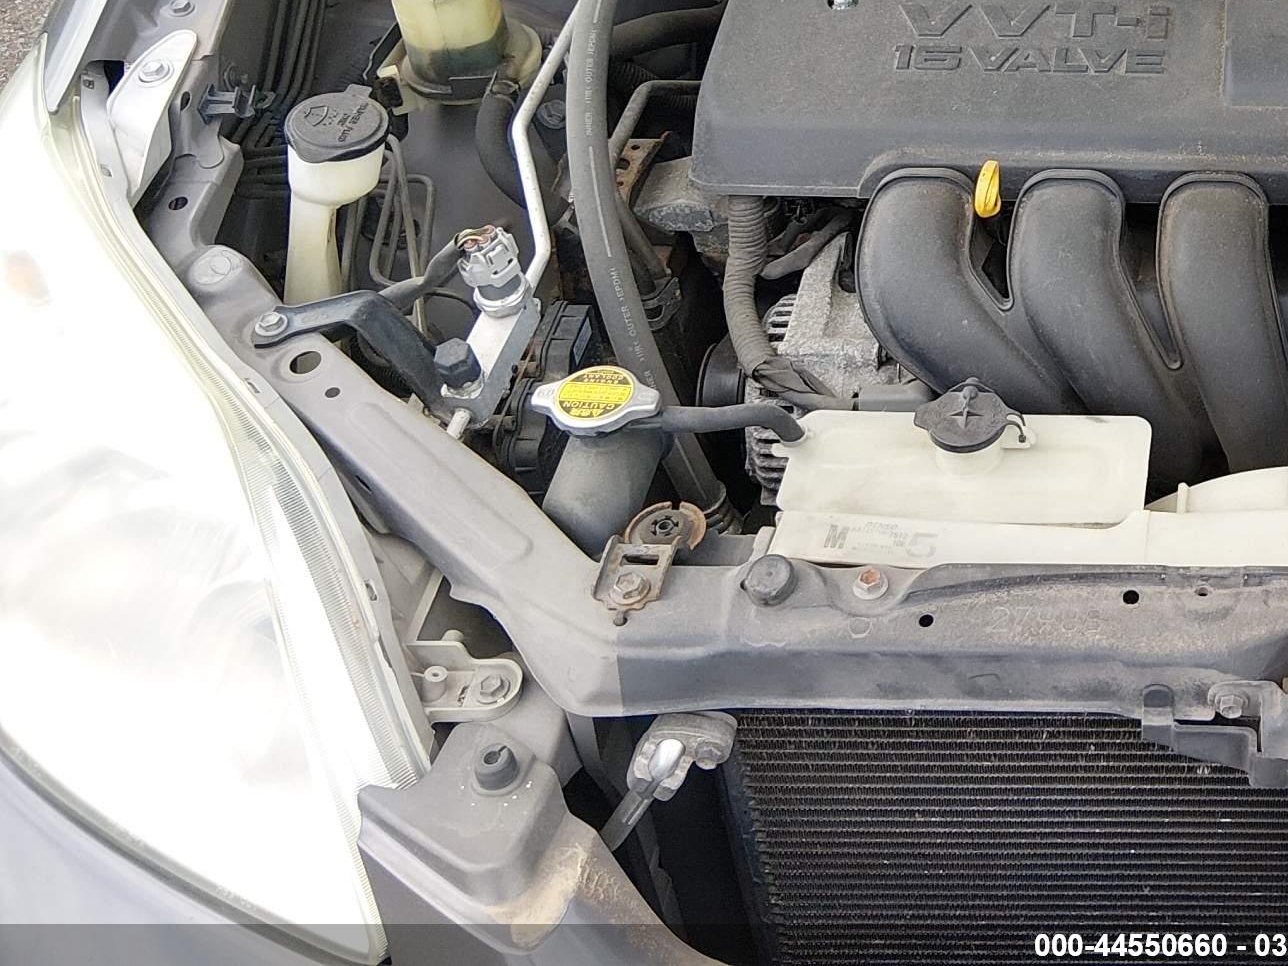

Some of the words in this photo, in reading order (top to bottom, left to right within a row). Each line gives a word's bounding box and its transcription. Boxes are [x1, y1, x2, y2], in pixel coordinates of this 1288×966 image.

[899, 3, 1172, 40] VVT-i
[895, 44, 963, 71] 16
[968, 46, 1167, 74] VALVE
[621, 305, 637, 337] OUTER
[563, 401, 615, 410] CAUTION
